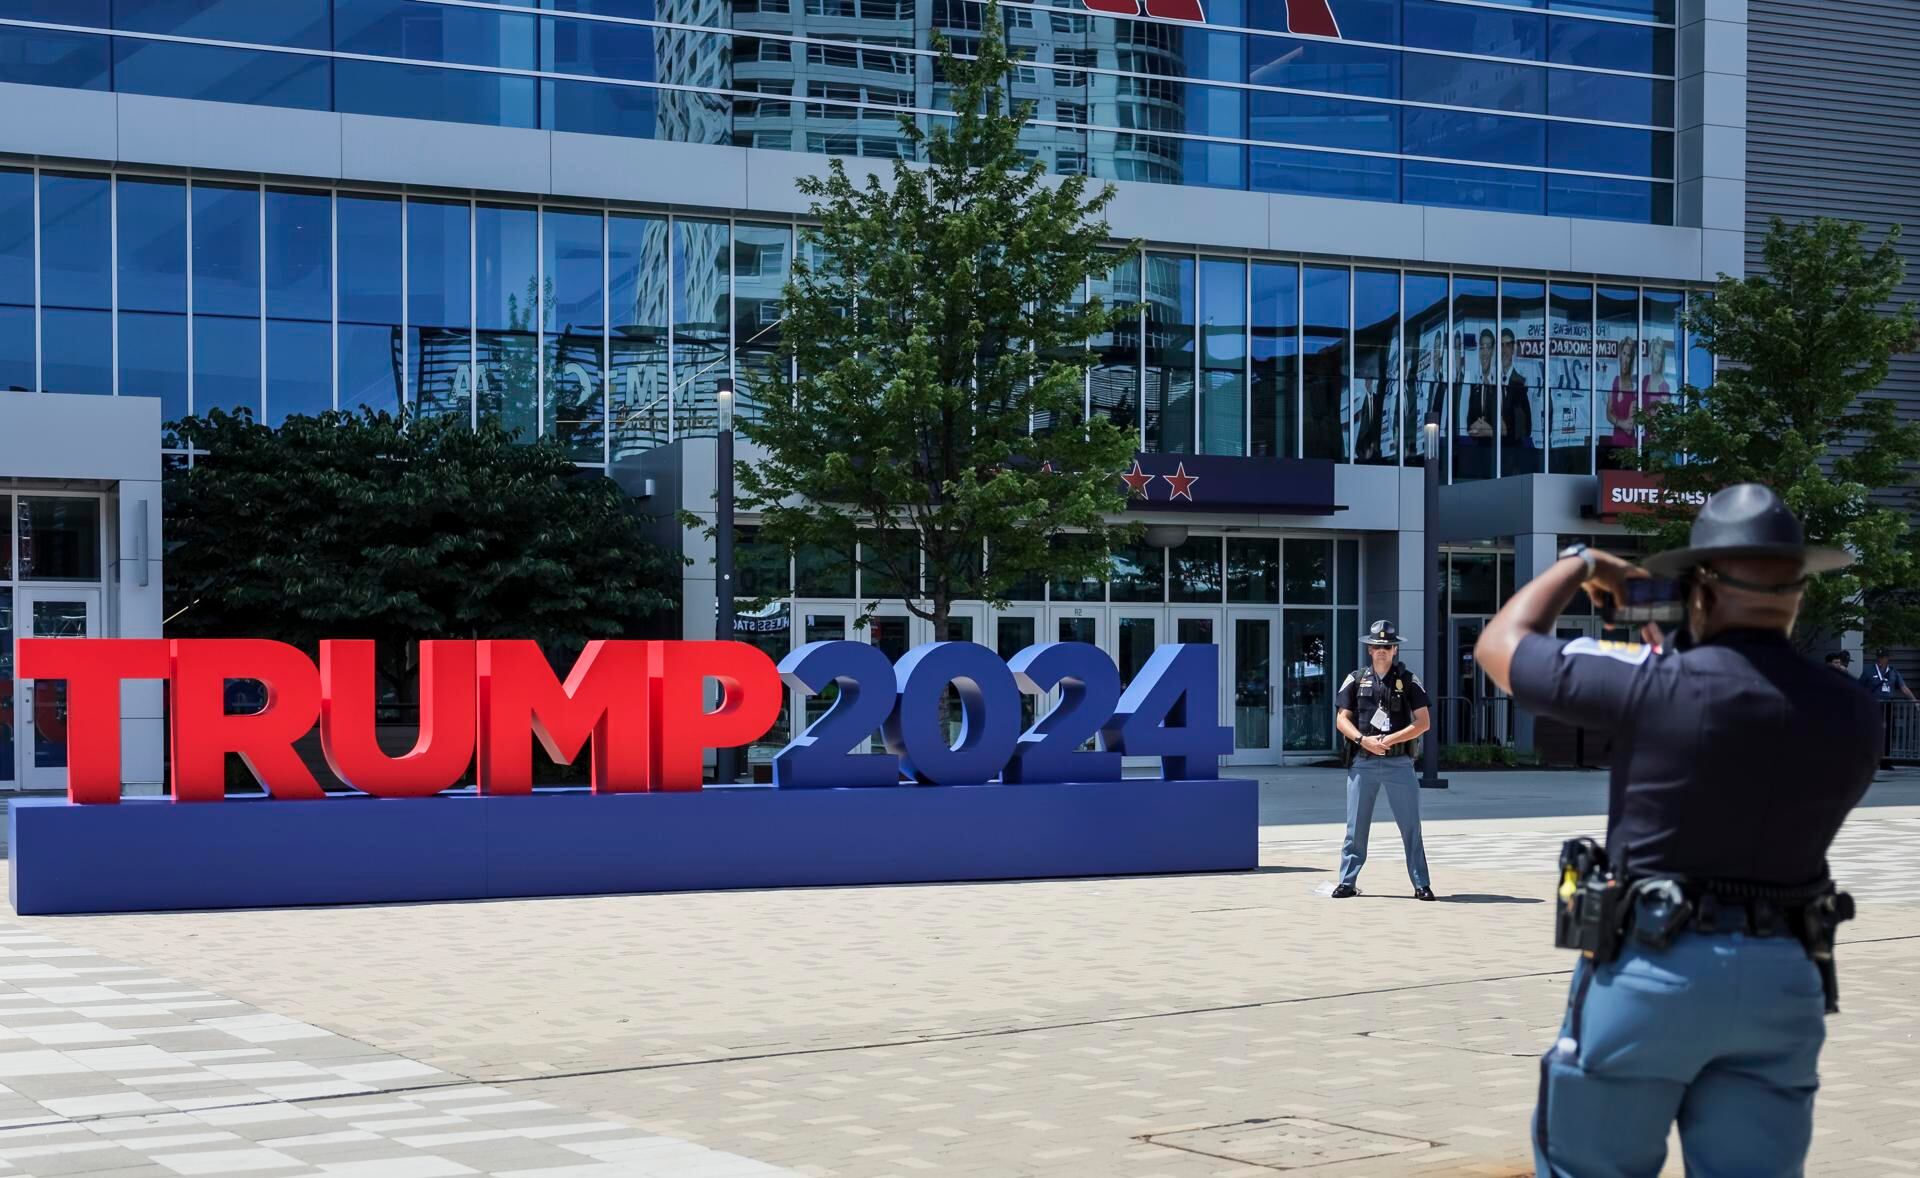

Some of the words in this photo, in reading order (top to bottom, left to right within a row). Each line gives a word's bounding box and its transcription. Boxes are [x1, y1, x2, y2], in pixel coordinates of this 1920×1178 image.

[1611, 487, 1659, 503] SUITE
[16, 638, 783, 804] TRUMP
[773, 640, 1234, 788] 2024
